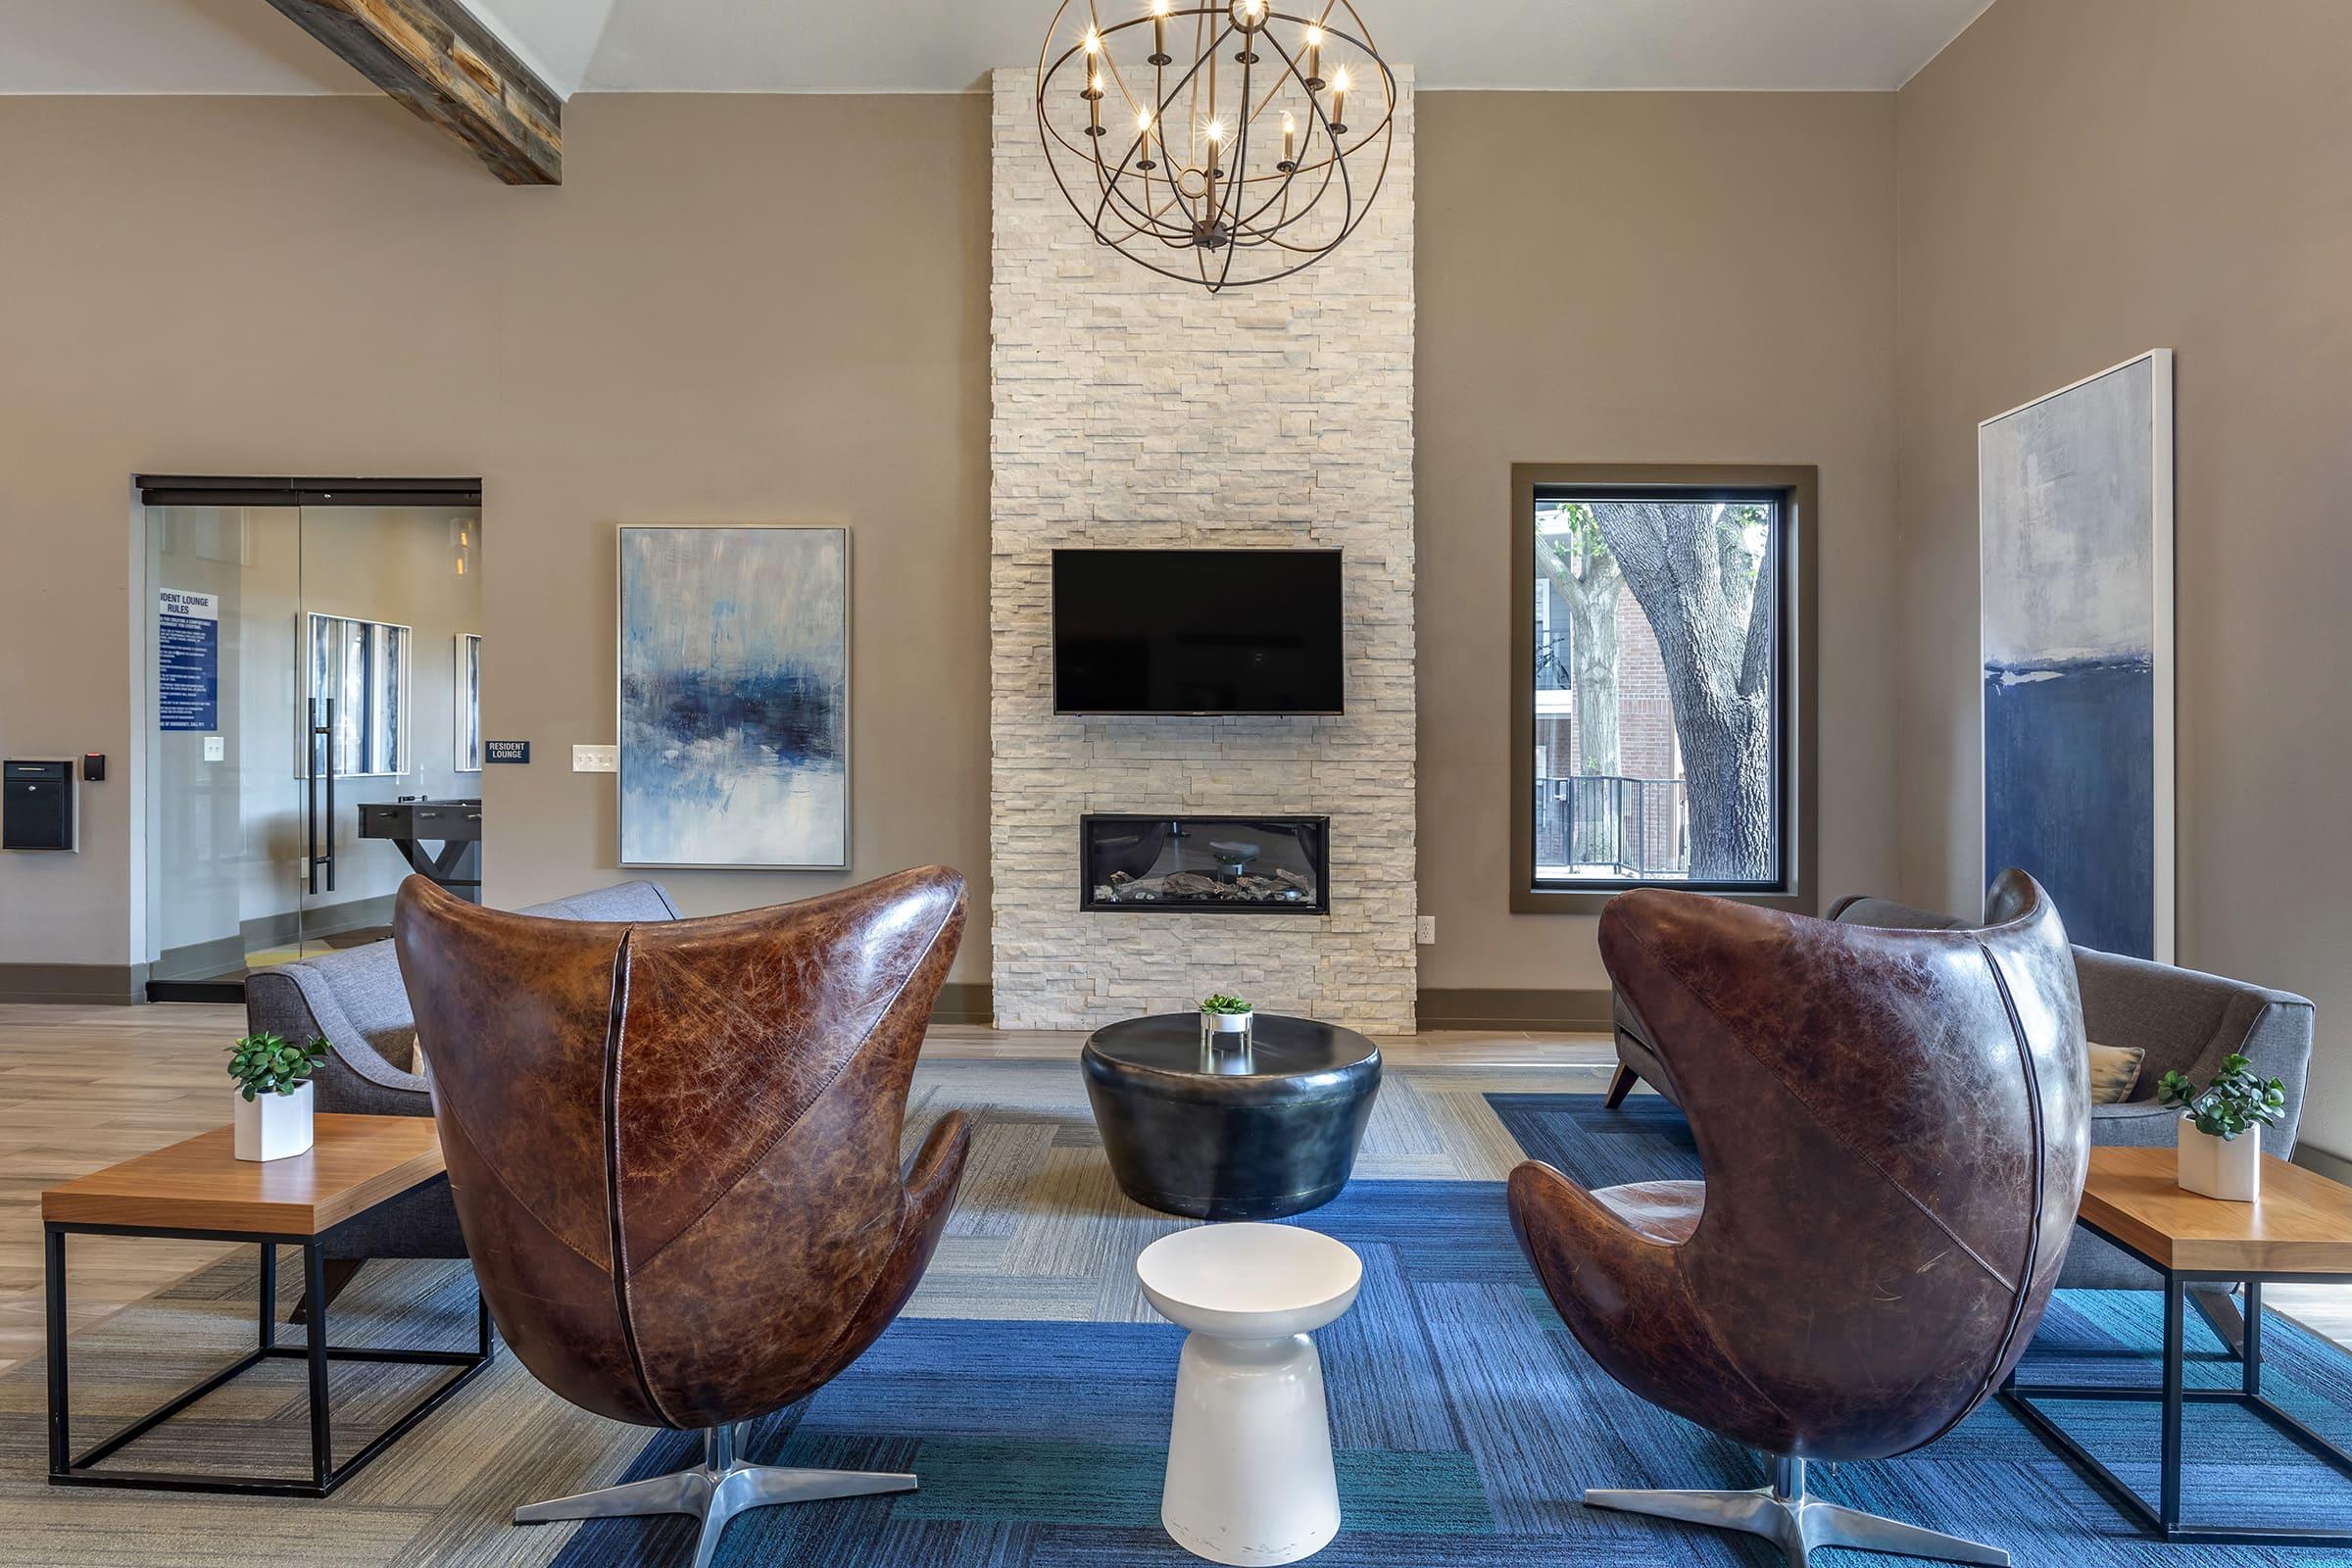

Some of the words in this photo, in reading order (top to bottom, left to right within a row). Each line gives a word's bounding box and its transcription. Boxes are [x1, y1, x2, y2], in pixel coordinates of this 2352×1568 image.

[161, 593, 180, 602] IDENT
[182, 595, 209, 607] LOUNGE
[168, 604, 189, 614] RULES
